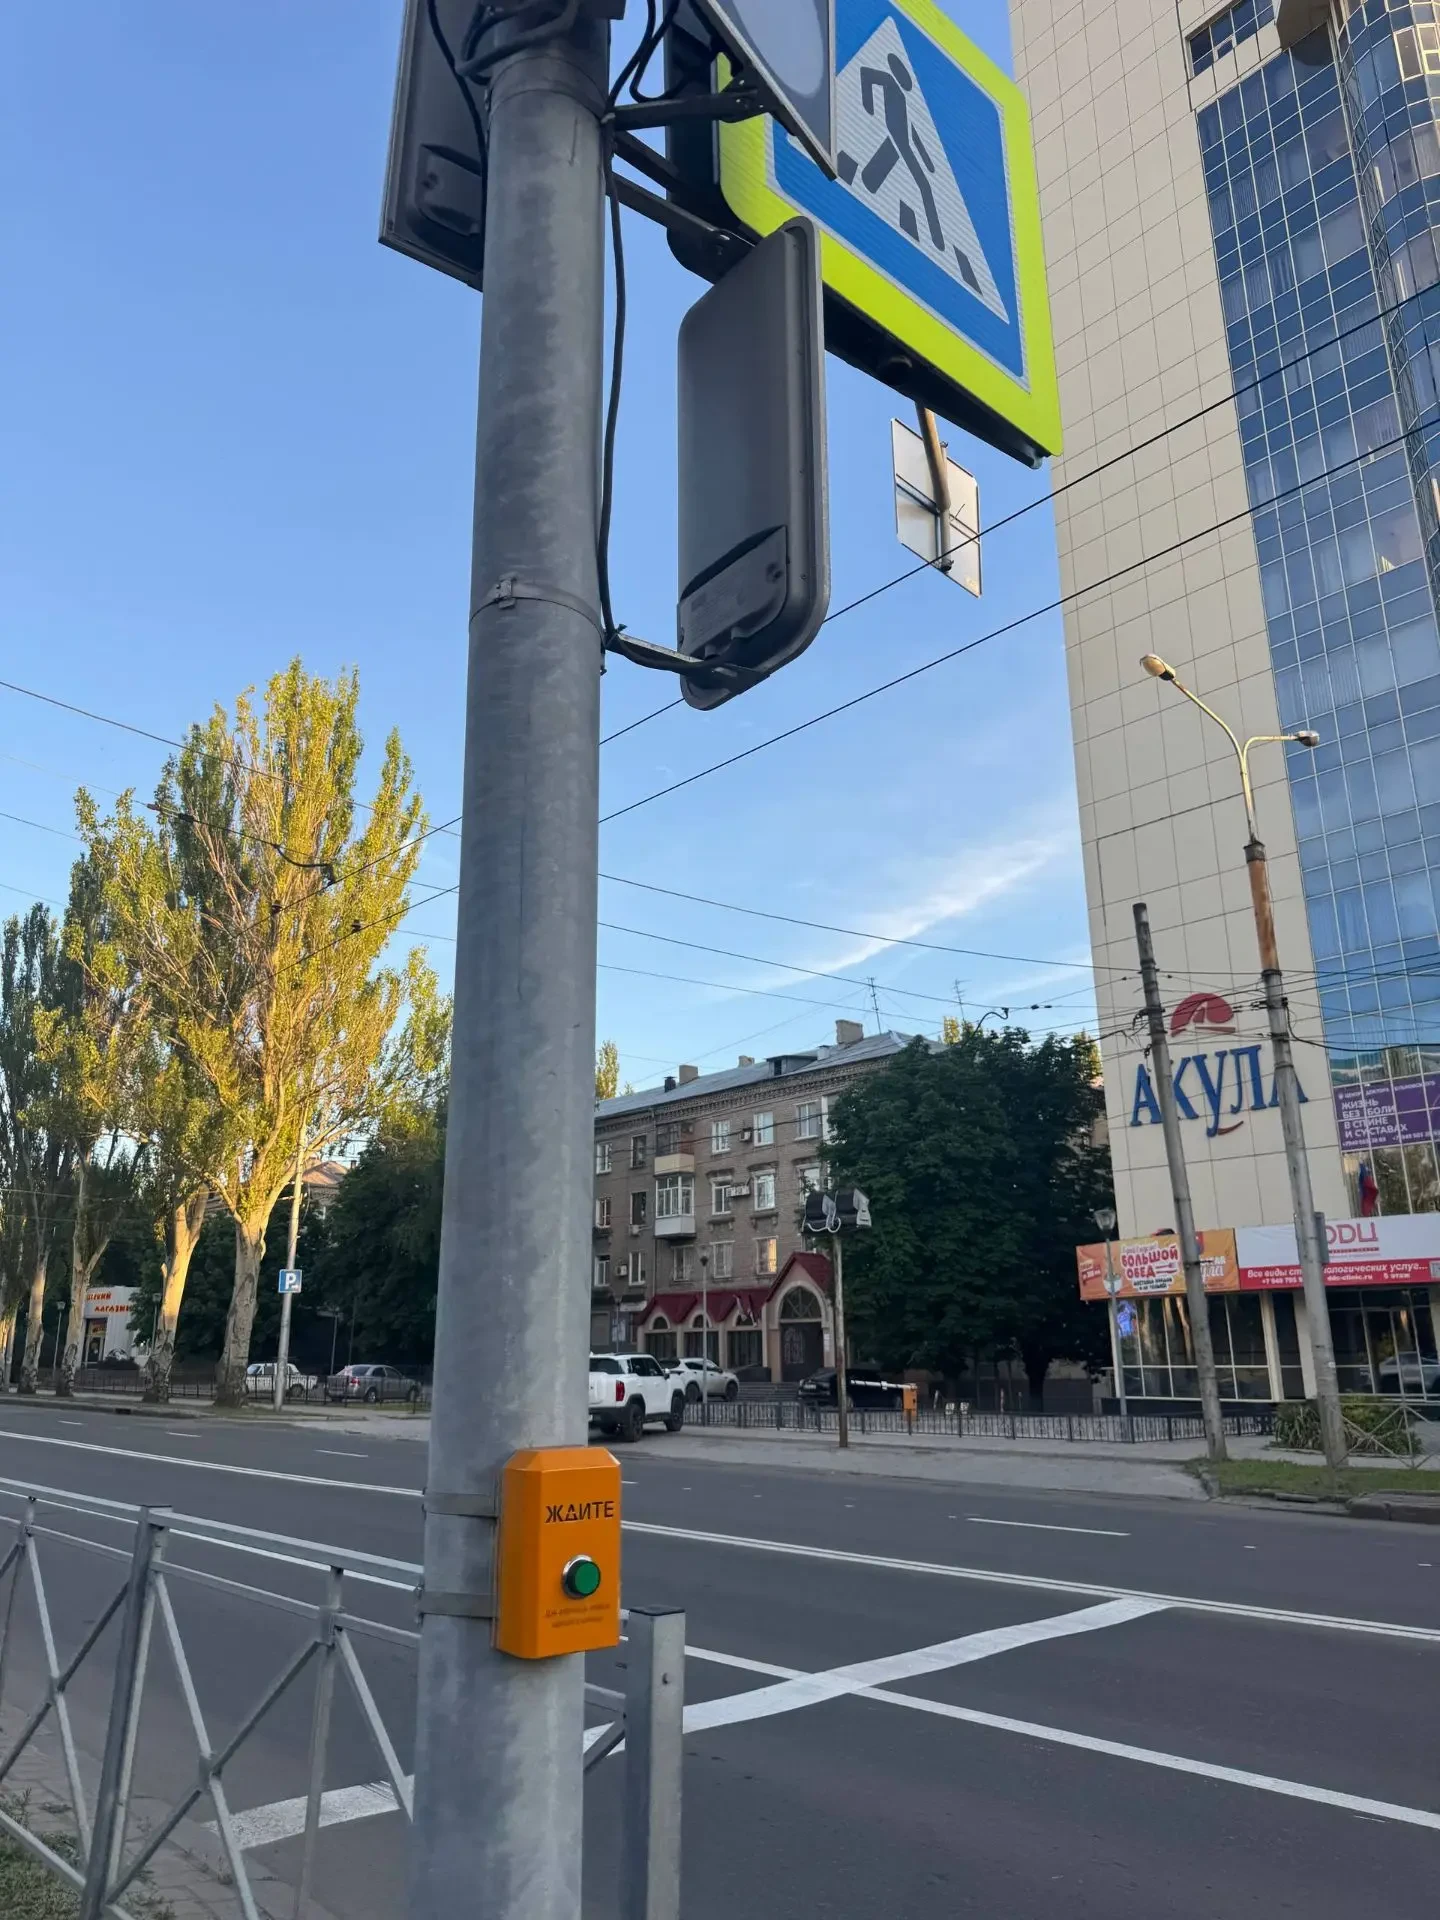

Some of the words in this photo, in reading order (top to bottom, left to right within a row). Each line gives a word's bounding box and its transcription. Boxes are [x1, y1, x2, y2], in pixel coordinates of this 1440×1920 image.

[1342, 1100, 1379, 1110] ЖИЗНЬ
[1367, 1106, 1395, 1115] БОЛИ
[1344, 1121, 1351, 1130] В
[1352, 1116, 1389, 1128] СПИНЕ
[1345, 1130, 1353, 1138] И
[1355, 1124, 1408, 1136] СУСТАВАХ
[1121, 1245, 1178, 1267] БОЛЬШОЙ
[1126, 1265, 1156, 1278] ОБЕД
[1247, 1269, 1263, 1278] Все
[1264, 1268, 1287, 1277] виды
[1289, 1263, 1387, 1276] стологических
[285, 1272, 297, 1290] P
[546, 1501, 614, 1523] ЖДИТЕ
